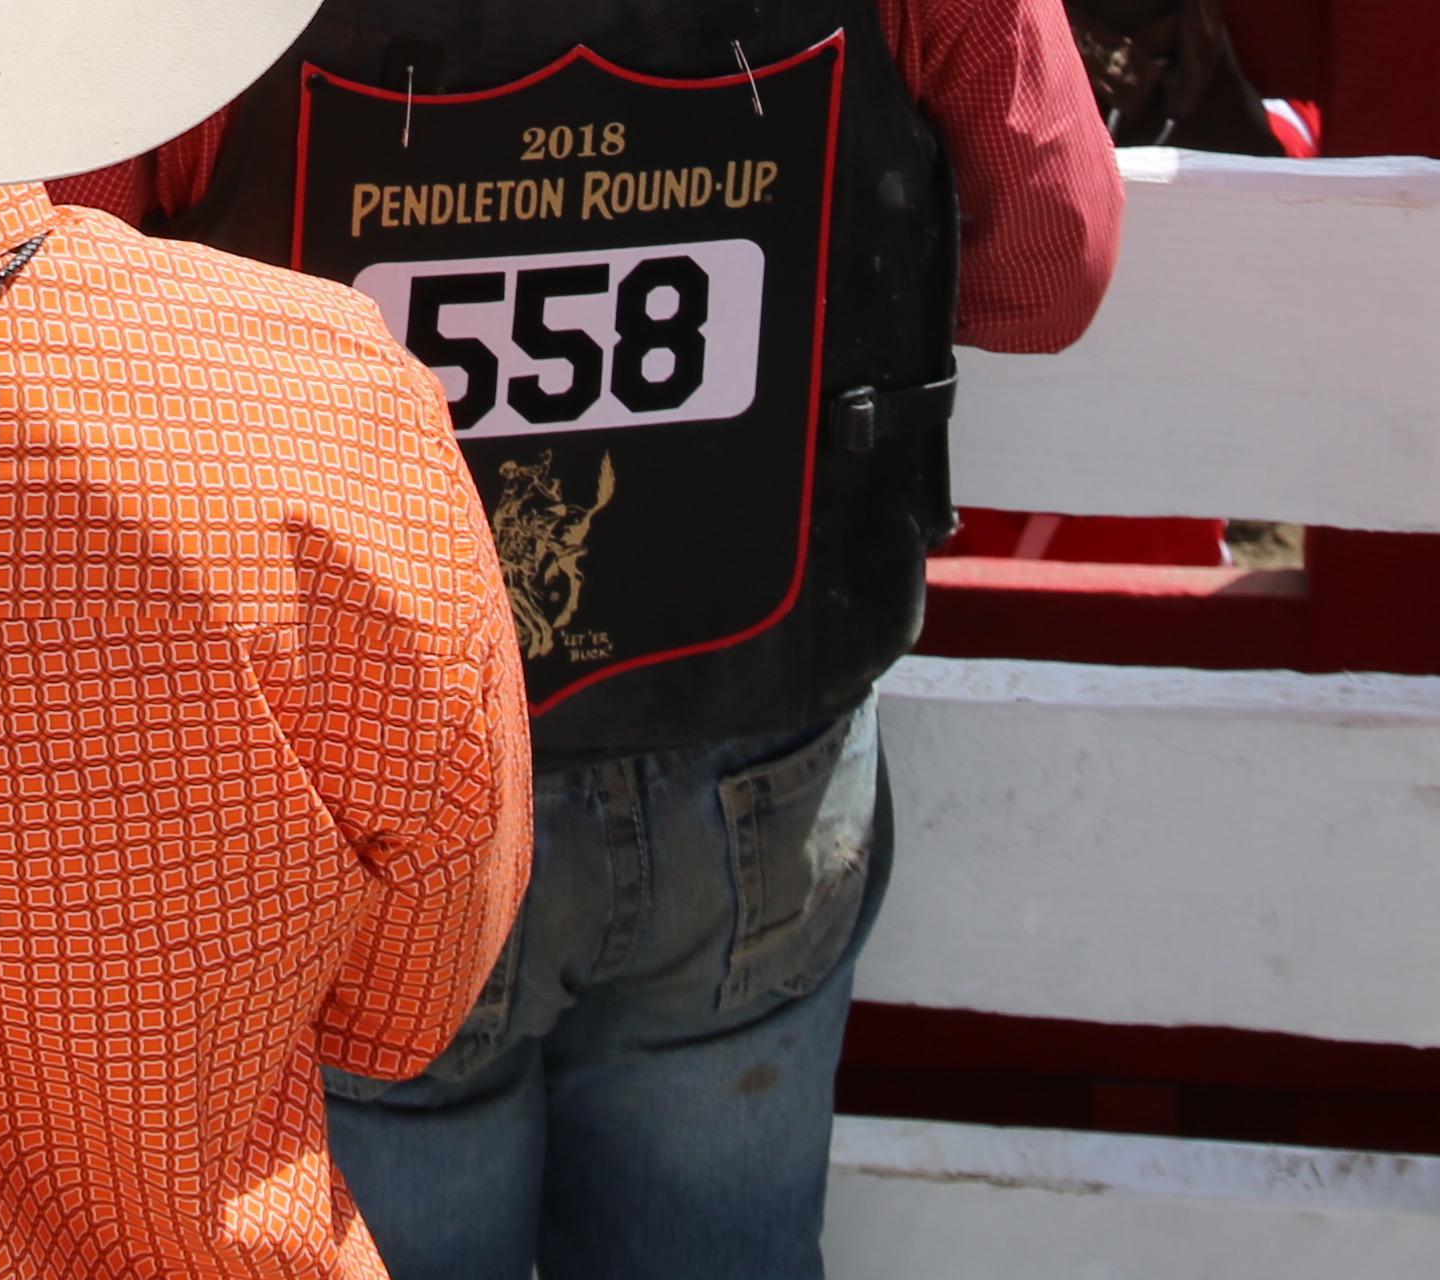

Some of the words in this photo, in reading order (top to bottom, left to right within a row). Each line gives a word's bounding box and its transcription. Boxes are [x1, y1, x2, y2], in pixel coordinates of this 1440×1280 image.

[521, 122, 626, 161] 2018
[351, 176, 565, 237] PENDLETON
[405, 255, 710, 432] 558
